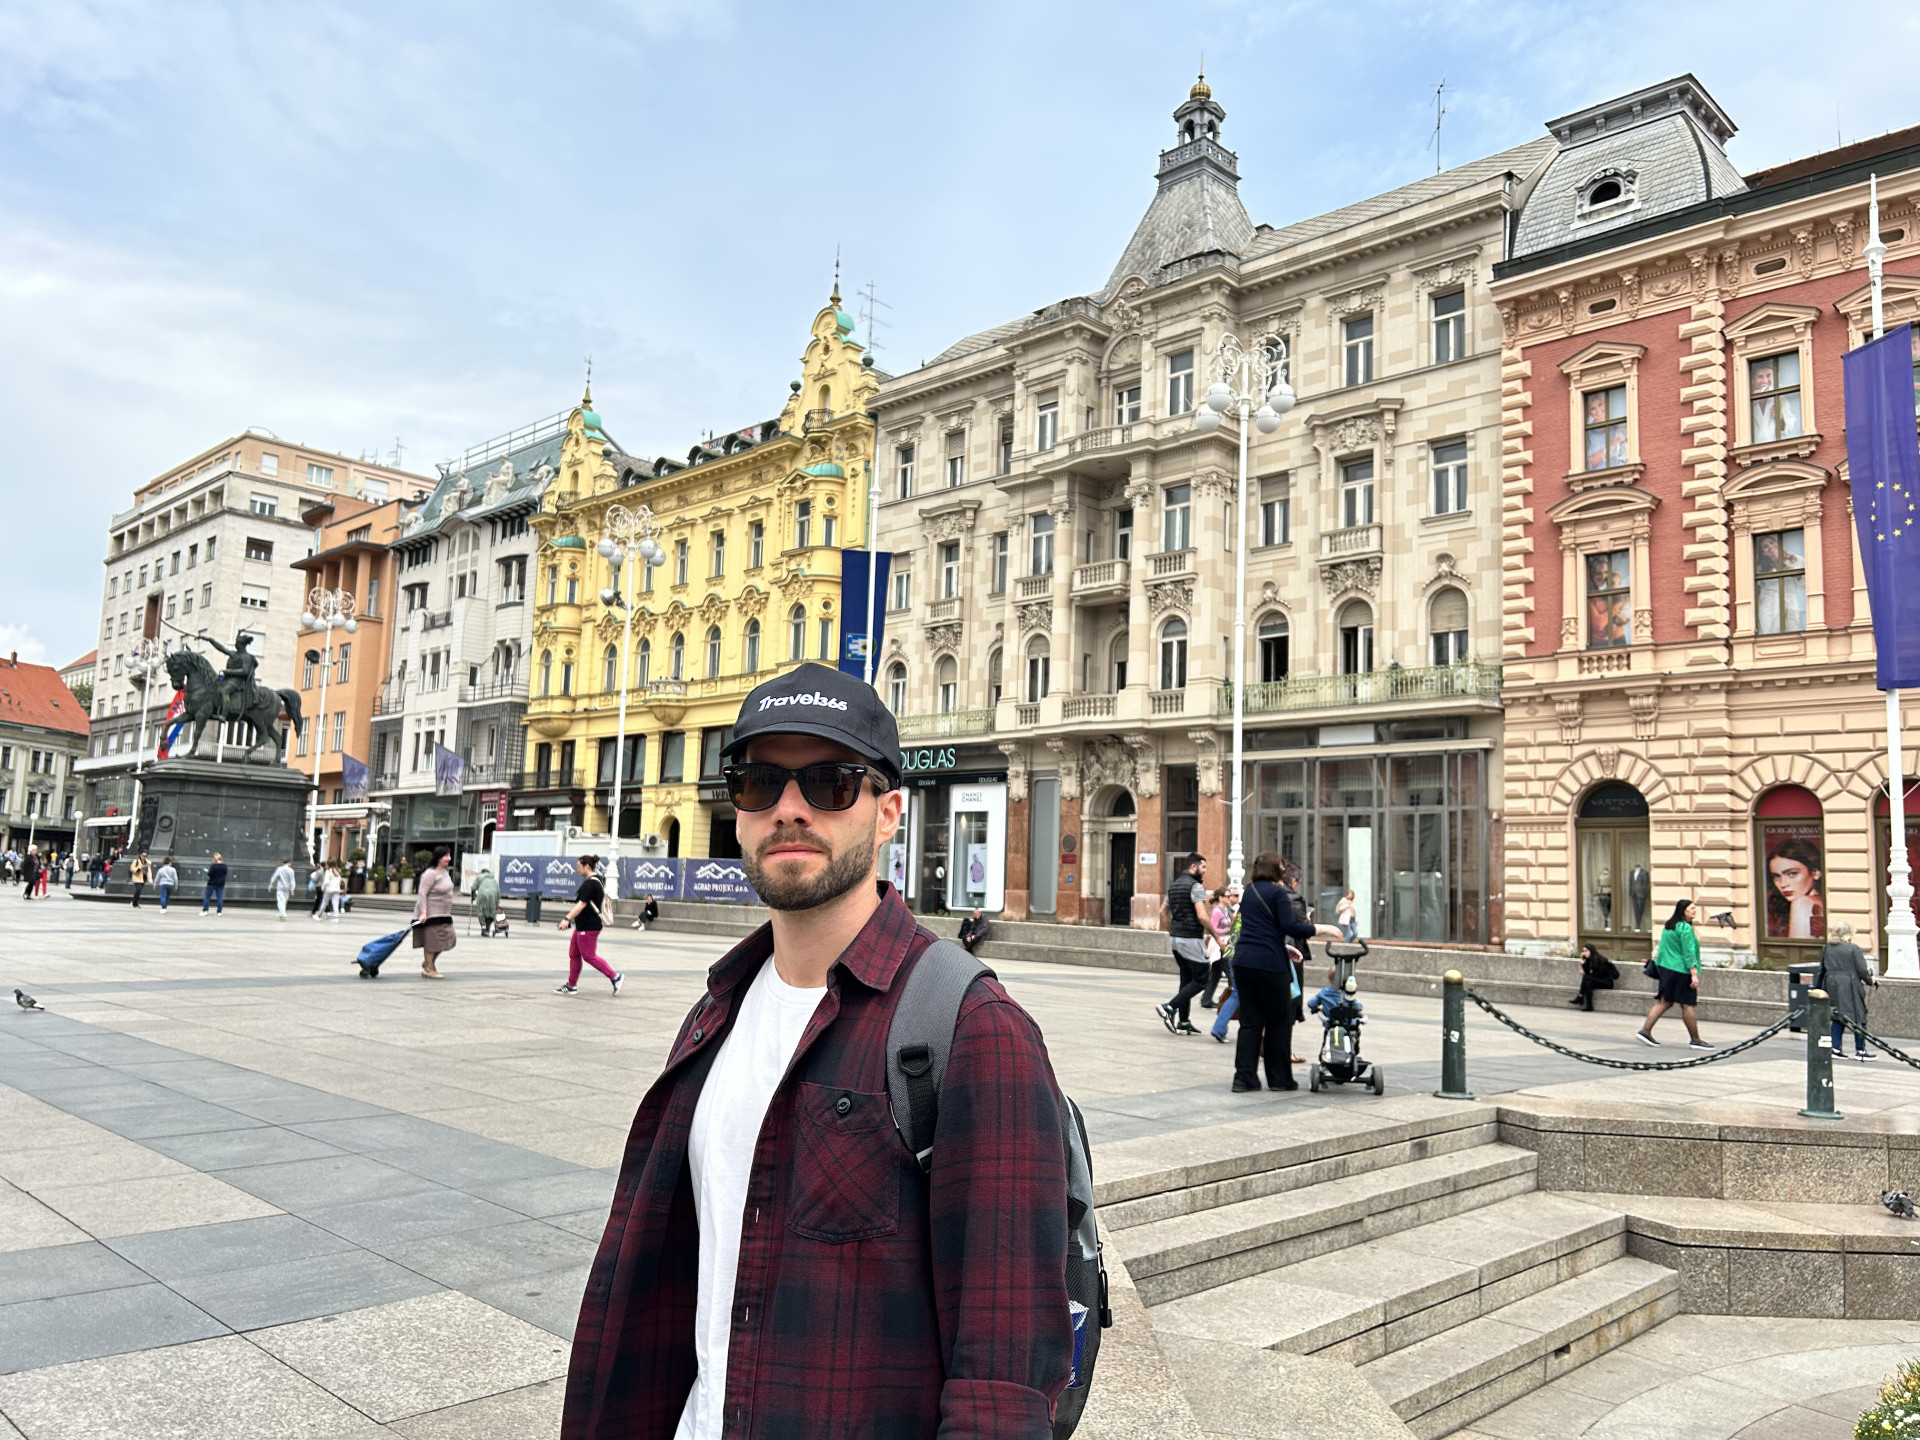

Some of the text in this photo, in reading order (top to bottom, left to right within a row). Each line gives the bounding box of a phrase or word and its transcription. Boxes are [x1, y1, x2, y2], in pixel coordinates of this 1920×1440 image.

[758, 692, 848, 712] Travel365
[900, 748, 956, 770] OUGLAS
[711, 883, 734, 893] PROJEKT
